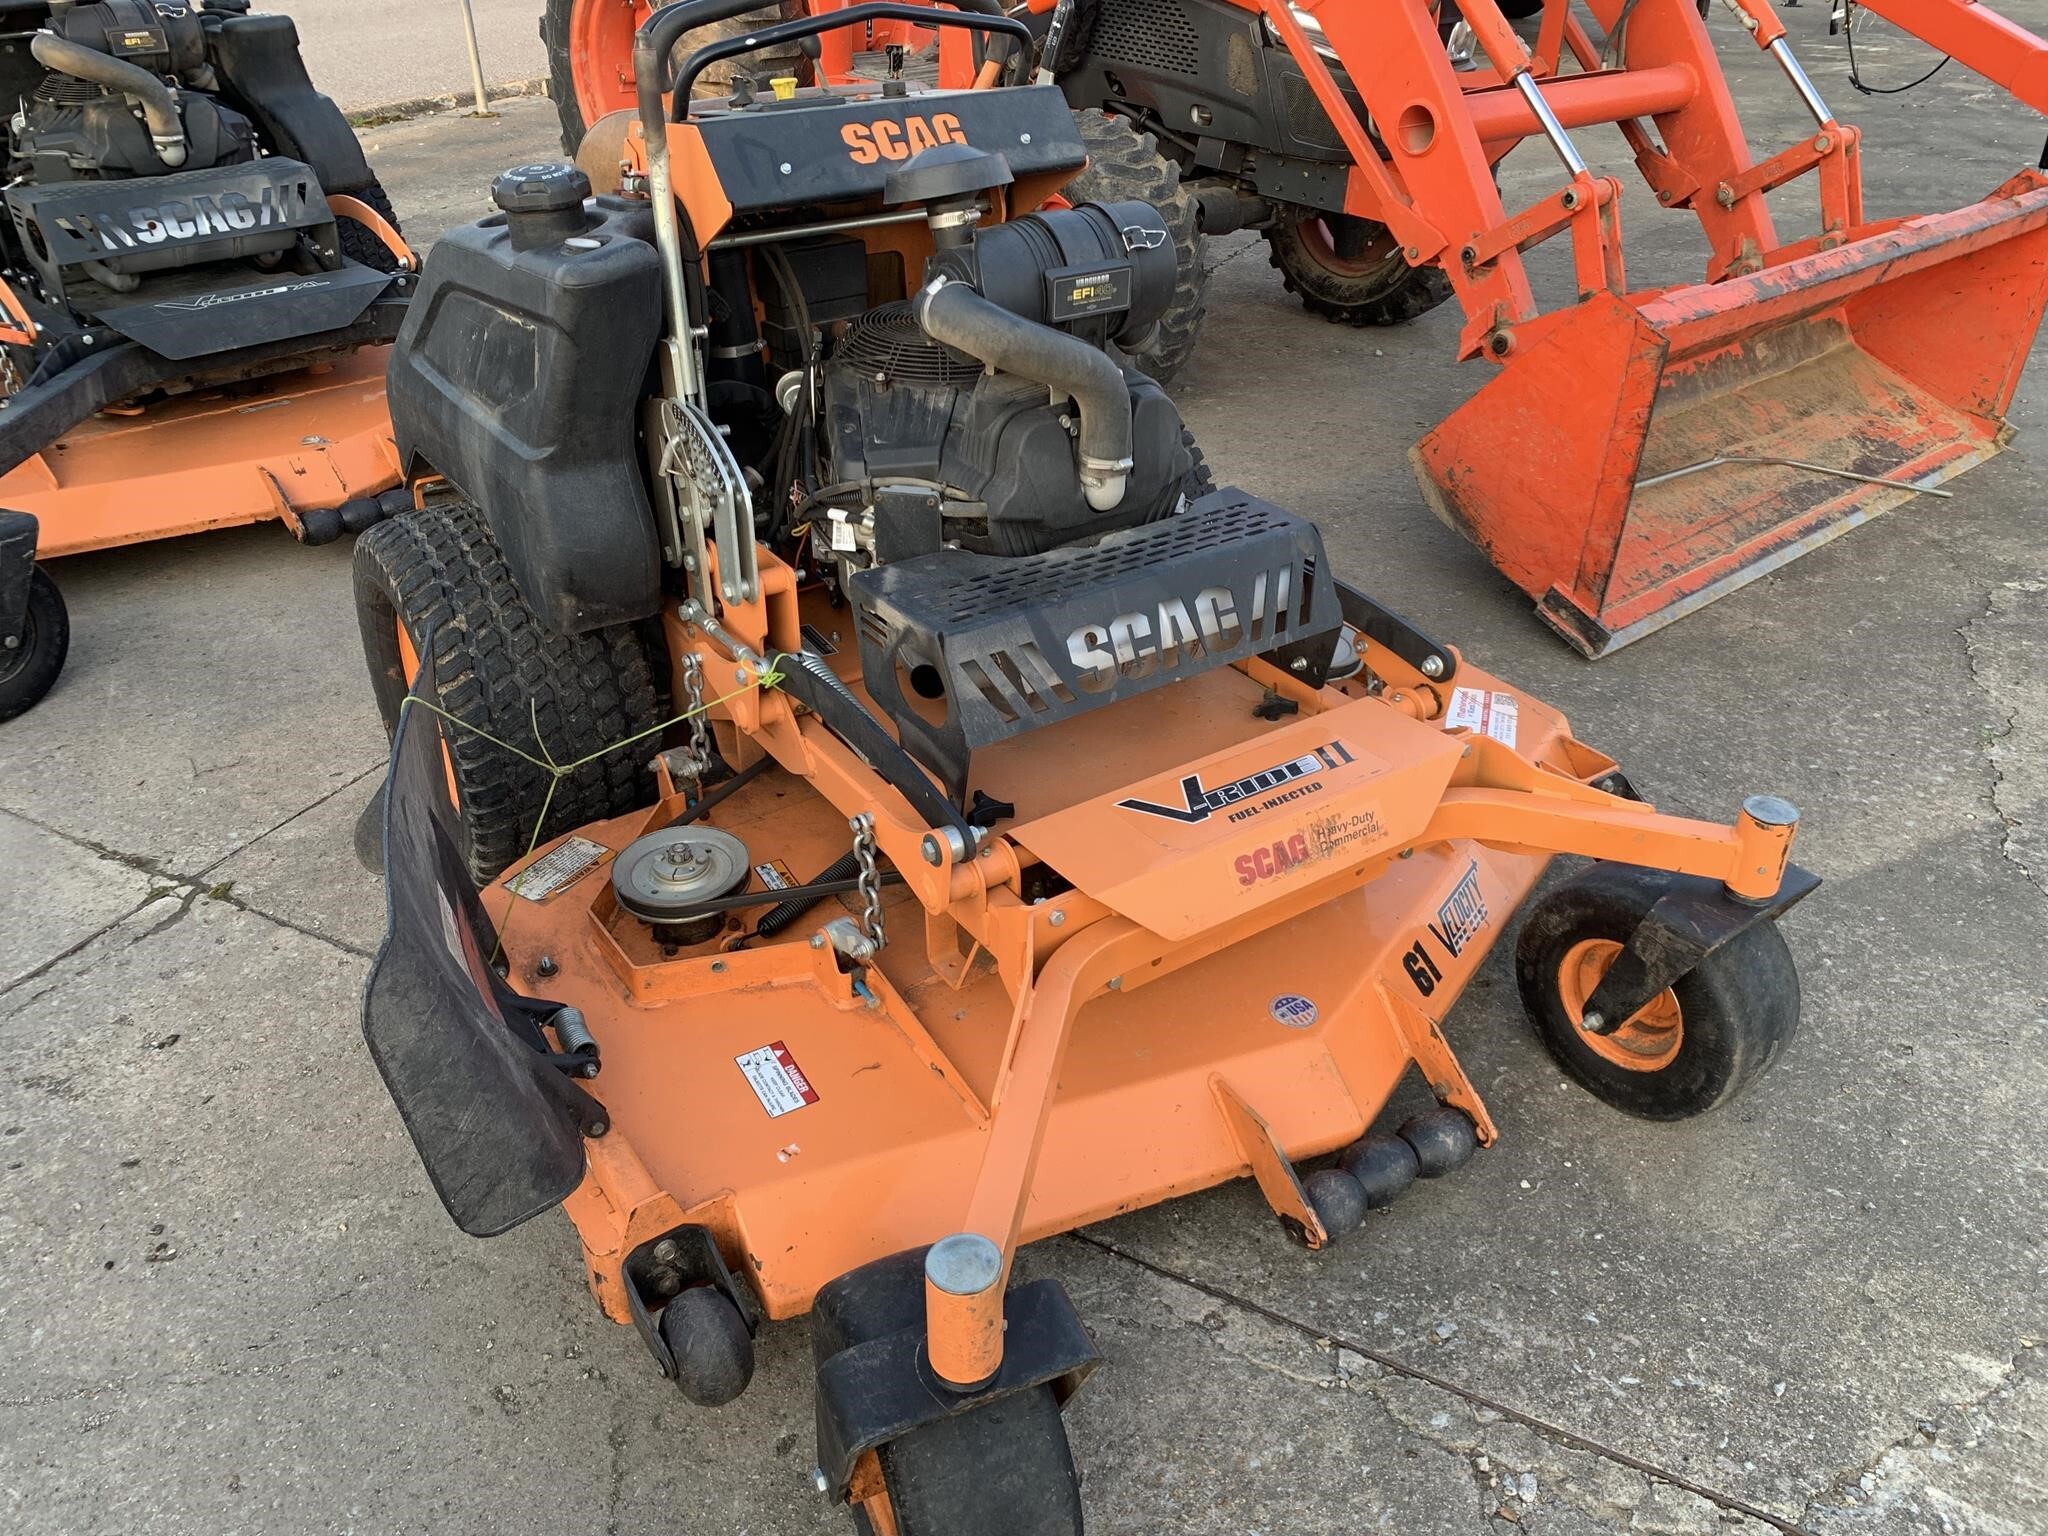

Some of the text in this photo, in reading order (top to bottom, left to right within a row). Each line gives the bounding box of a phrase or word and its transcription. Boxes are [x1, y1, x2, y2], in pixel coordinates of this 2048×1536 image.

[840, 112, 968, 165] SCAG
[128, 191, 256, 244] SCAG
[1073, 286, 1095, 301] EFI
[1066, 585, 1244, 694] SCAG
[1313, 739, 1358, 771] II
[1227, 781, 1324, 824] FUEL-INJECTED
[1317, 811, 1375, 841] Heavy-Duty
[1319, 820, 1379, 853] Commercial
[1233, 831, 1310, 887] SCAG
[1428, 859, 1483, 958] VELOCITY
[1402, 940, 1443, 997] 61
[1286, 999, 1314, 1016] USA
[784, 1064, 809, 1093] DANGER
